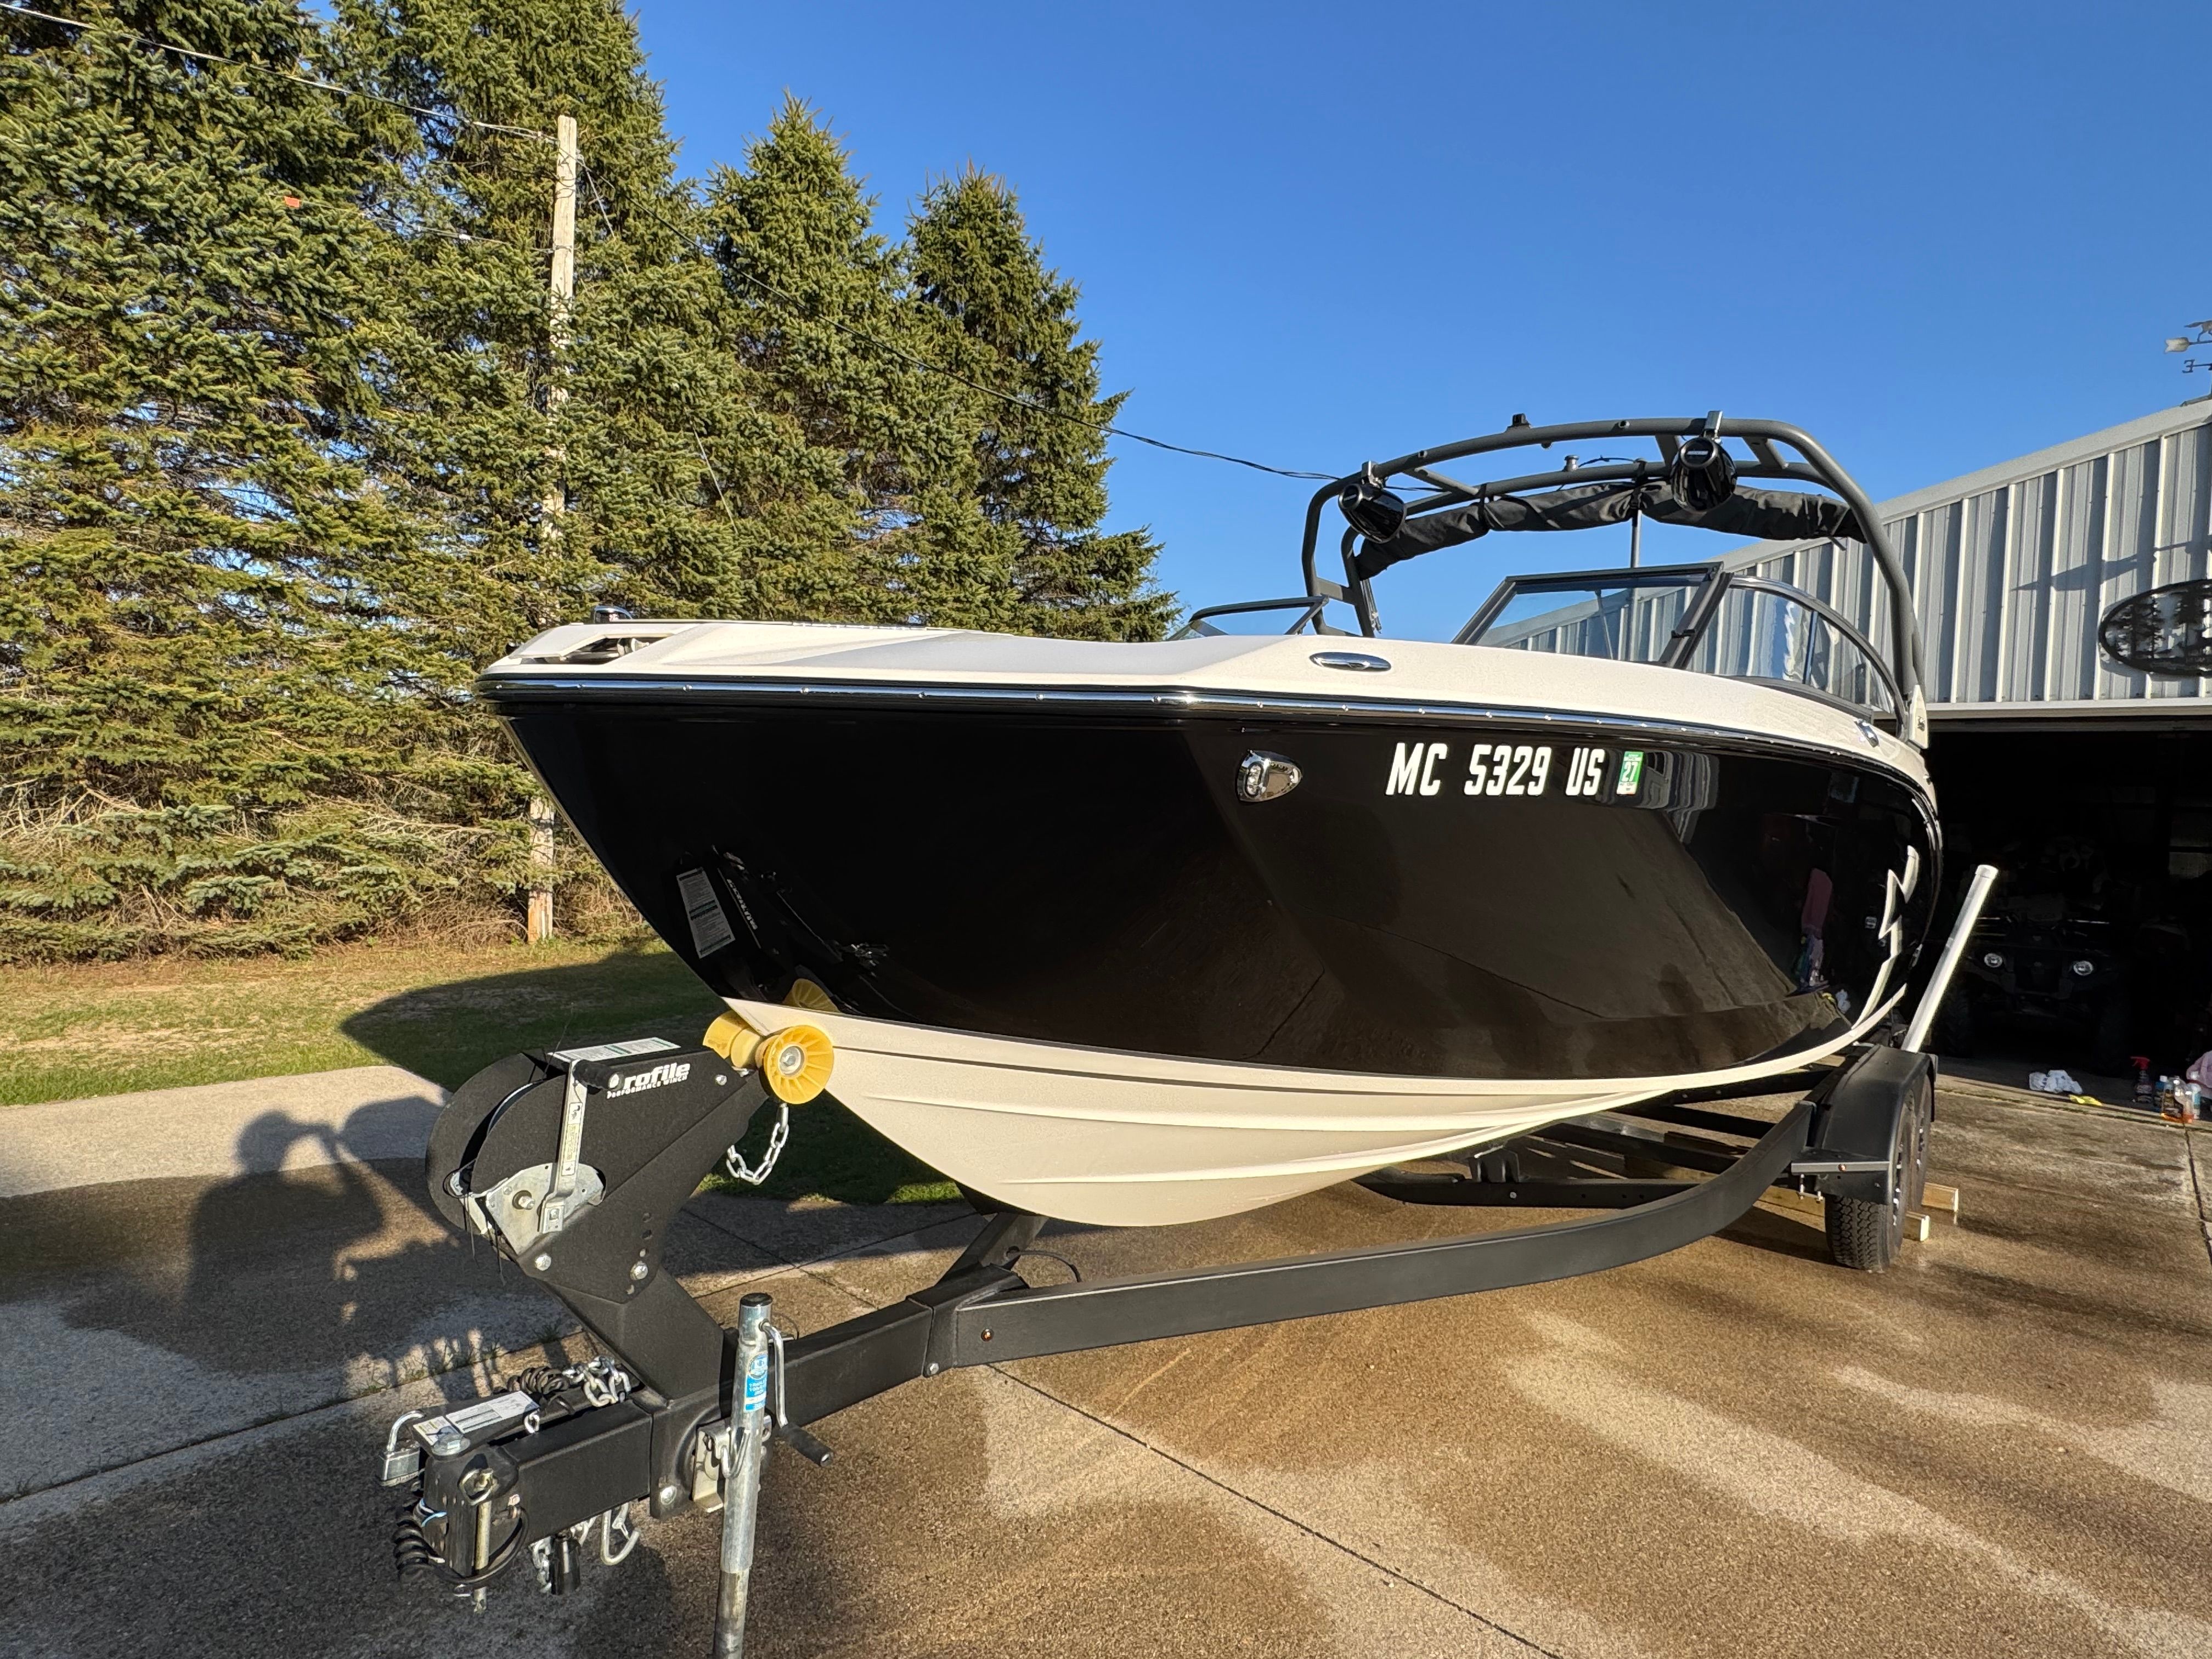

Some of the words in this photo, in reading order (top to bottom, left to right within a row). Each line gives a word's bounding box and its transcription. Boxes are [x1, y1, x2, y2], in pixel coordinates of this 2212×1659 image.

[1385, 742, 1448, 795] MC
[1464, 744, 1552, 796] 5329
[1565, 747, 1605, 795] US
[1621, 761, 1638, 782] 27
[610, 1062, 690, 1090] rofile
